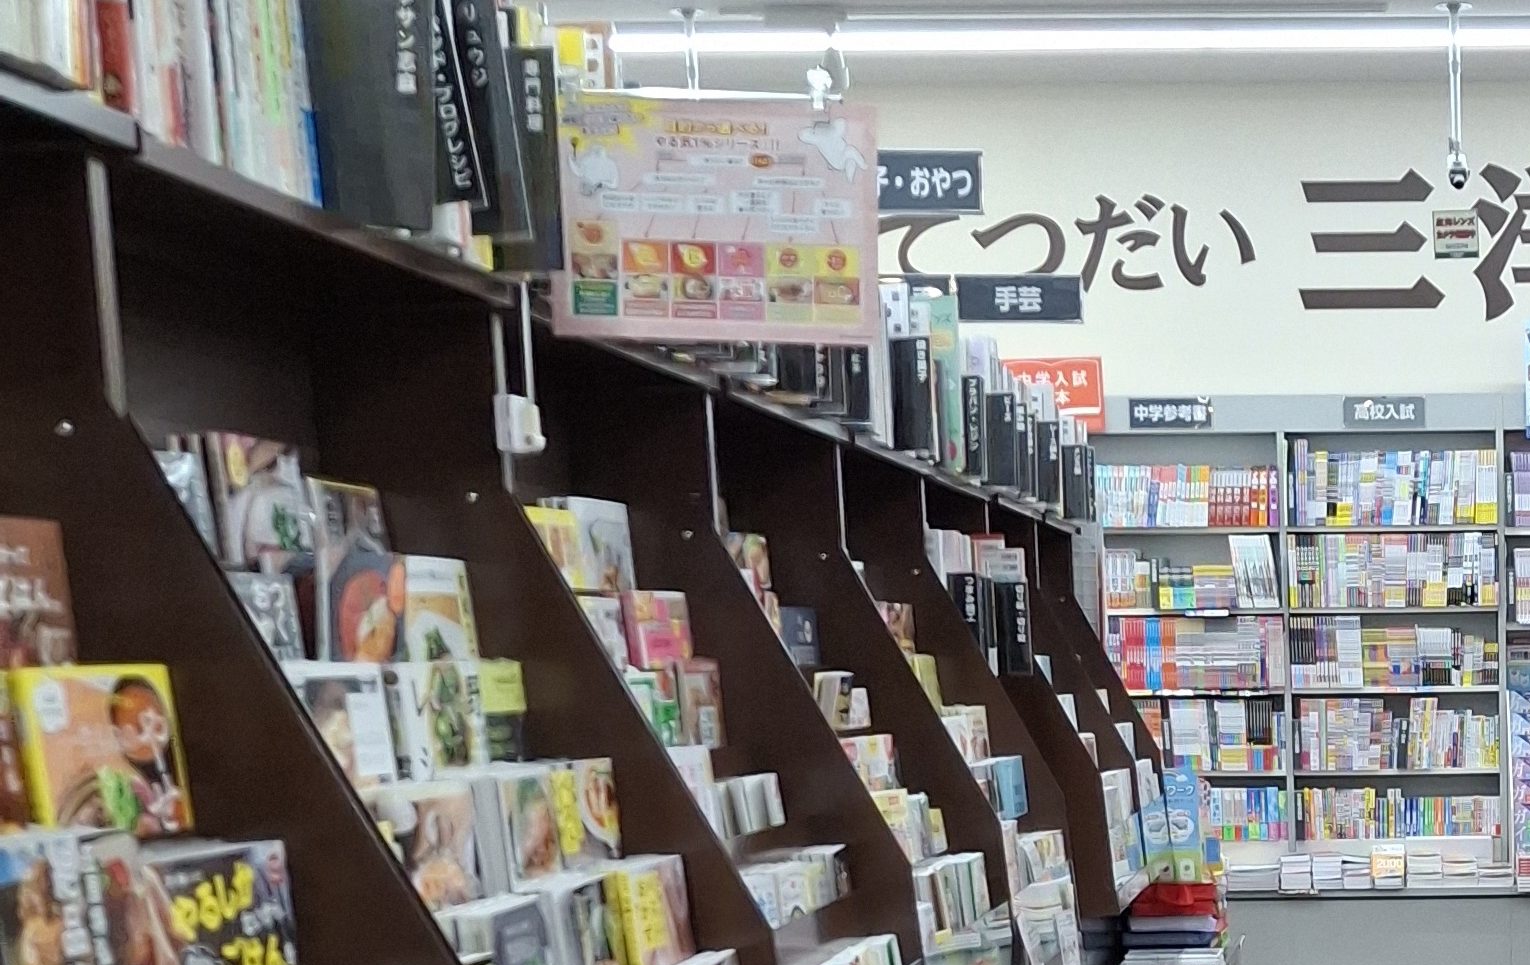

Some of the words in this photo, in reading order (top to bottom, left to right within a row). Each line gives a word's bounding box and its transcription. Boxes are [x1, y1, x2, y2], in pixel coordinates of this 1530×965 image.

[994, 286, 1042, 314] 手芸
[1353, 403, 1415, 420] 高校入試
